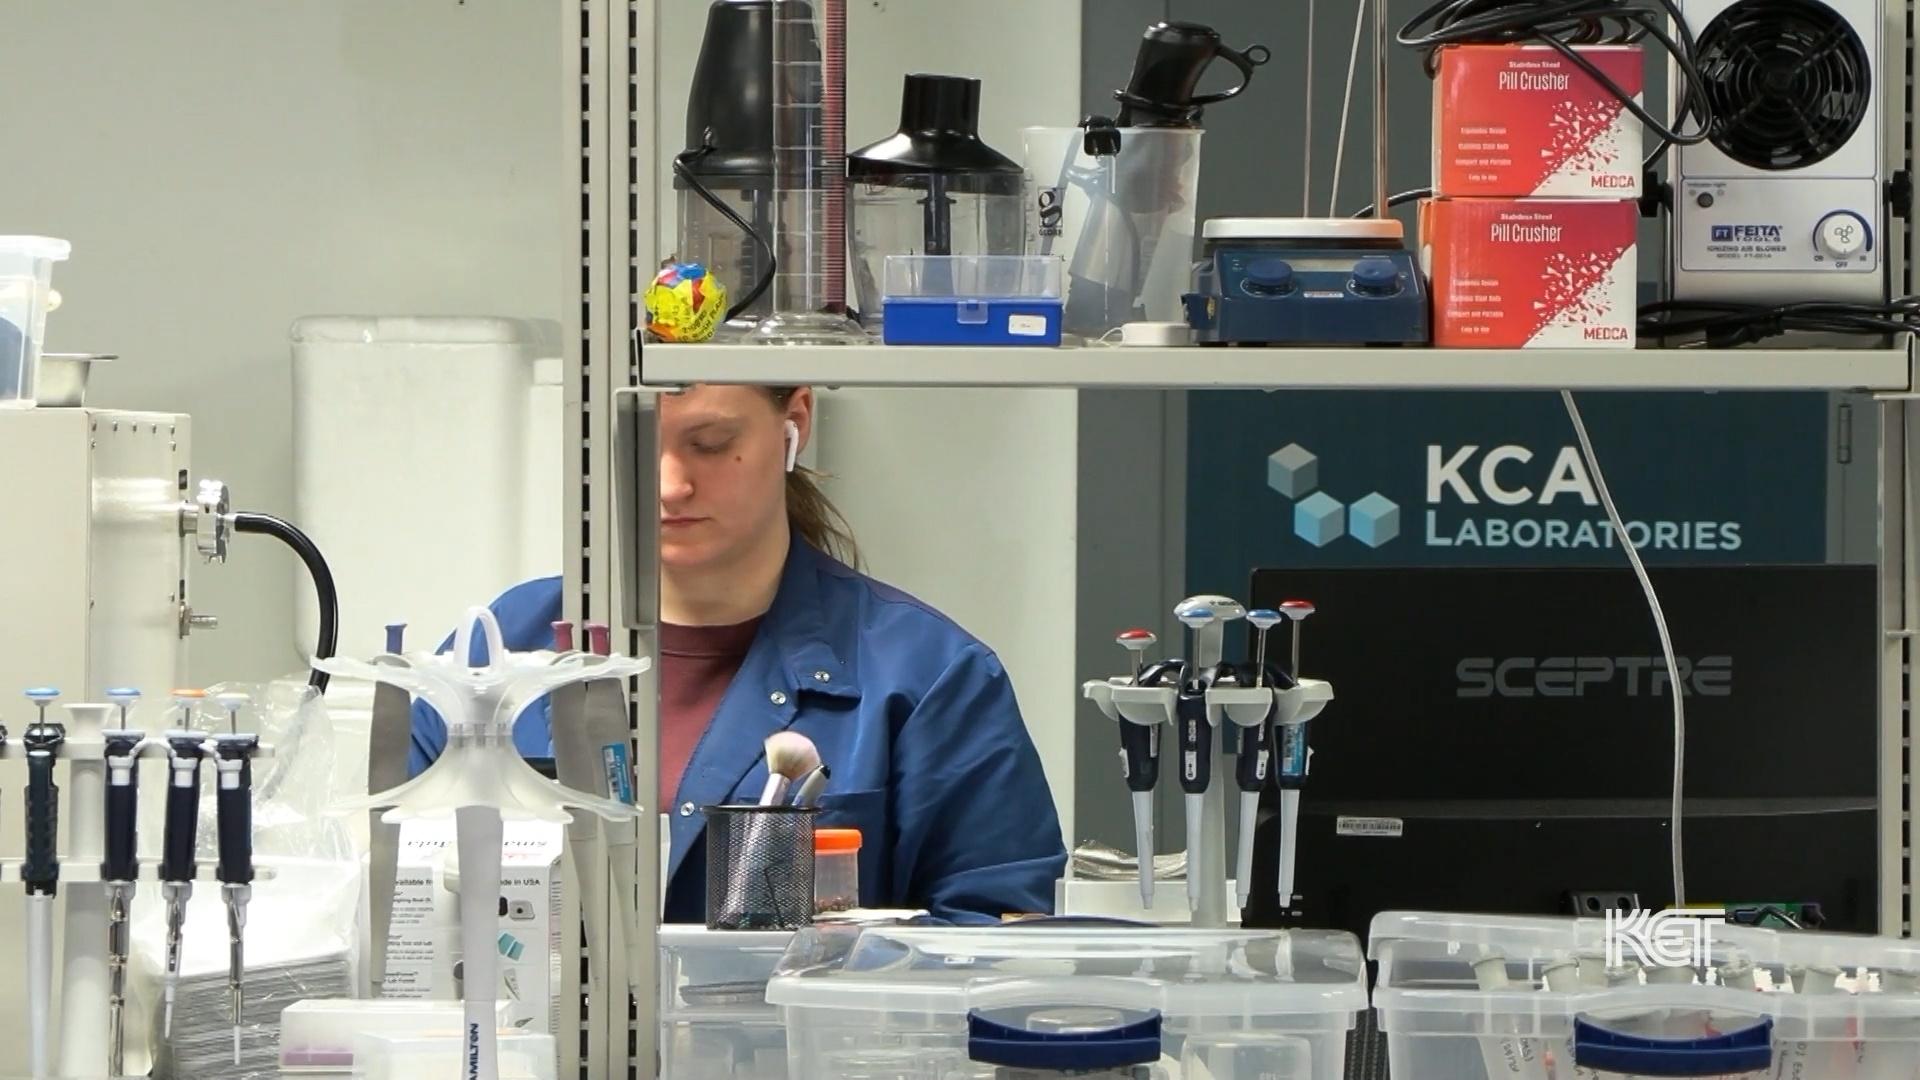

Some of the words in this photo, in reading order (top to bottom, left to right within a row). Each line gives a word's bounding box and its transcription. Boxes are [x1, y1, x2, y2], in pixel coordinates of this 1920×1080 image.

[1499, 71, 1518, 90] Pill
[1520, 71, 1569, 90] Crusher
[1591, 175, 1635, 188] MEDCA
[1490, 223, 1510, 242] Pill
[1512, 223, 1562, 243] Crusher
[1584, 327, 1628, 340] MEDCA
[1427, 445, 1599, 505] KCA
[1426, 510, 1742, 549] LABORATORIES
[1456, 656, 1732, 697] SCEPTRE
